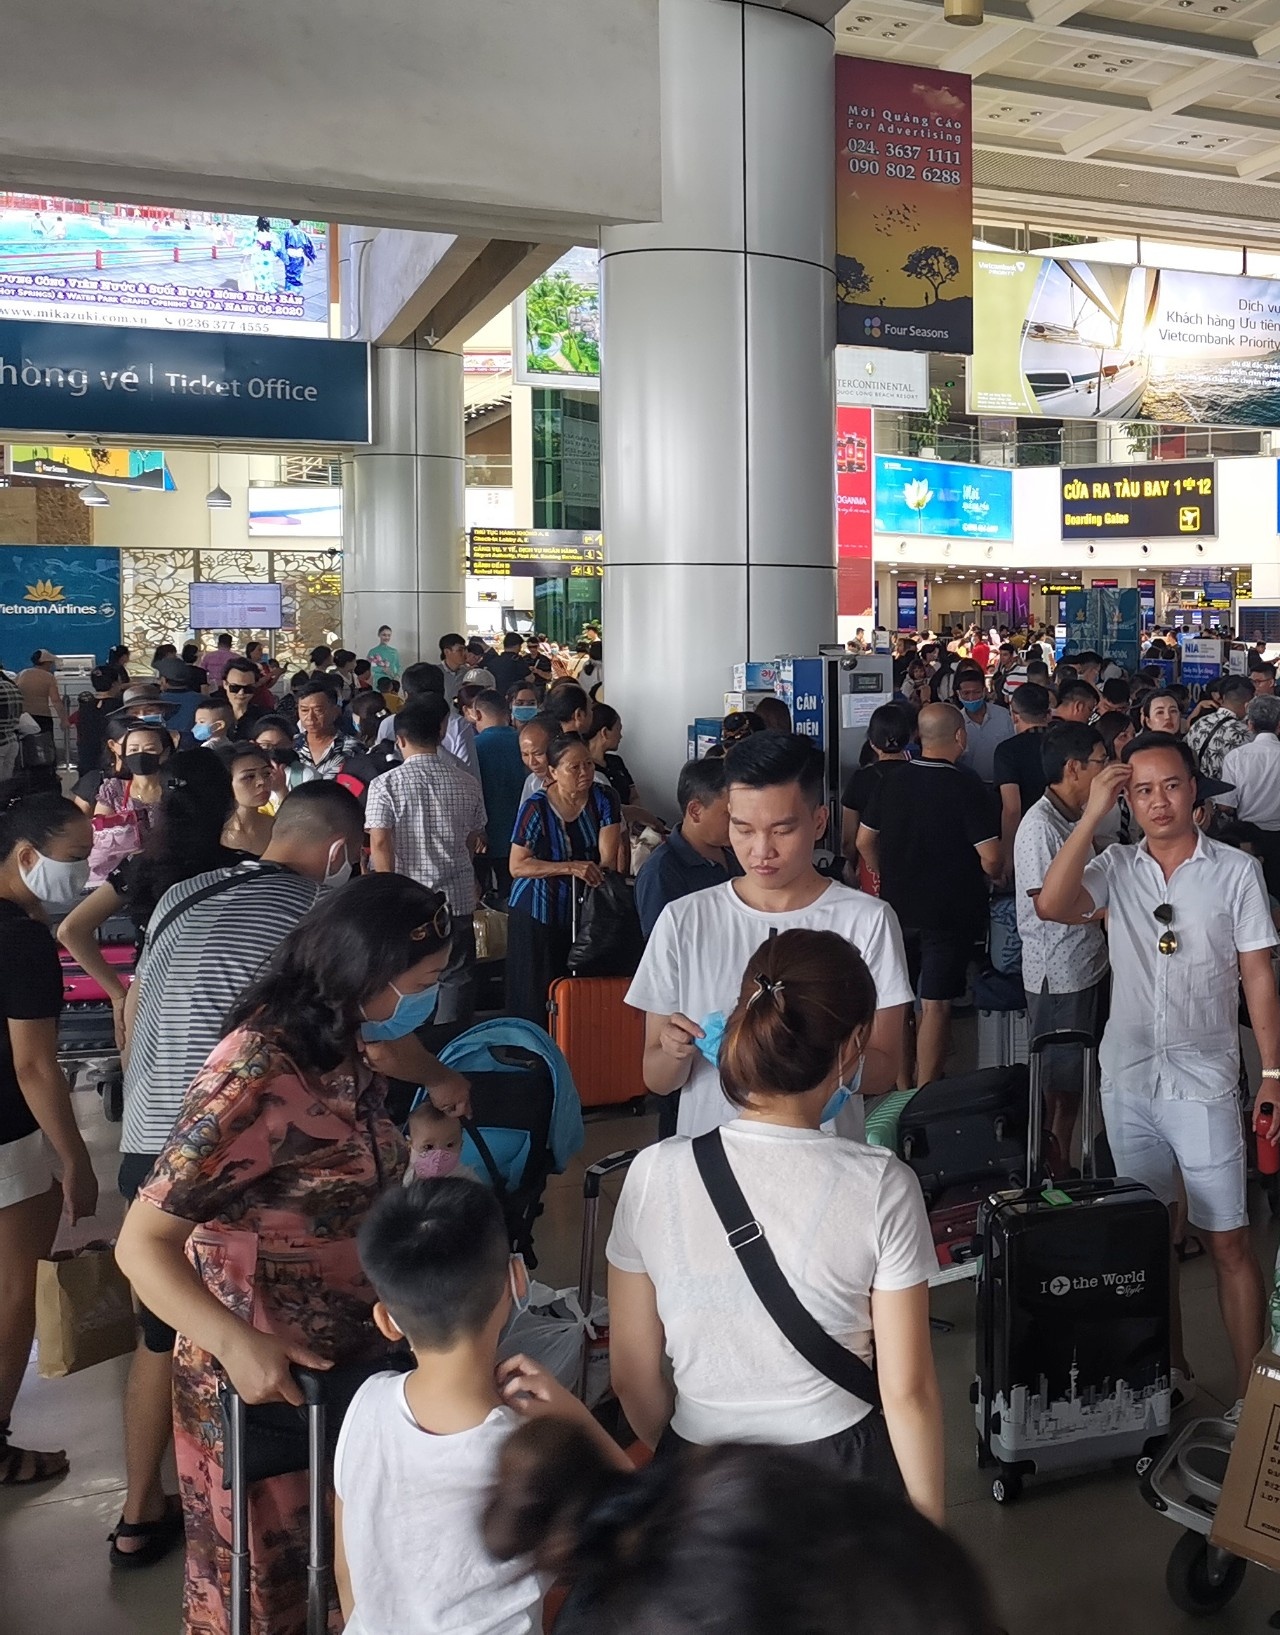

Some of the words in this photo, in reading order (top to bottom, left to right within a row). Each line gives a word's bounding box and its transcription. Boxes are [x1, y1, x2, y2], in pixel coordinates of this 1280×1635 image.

[848, 105, 875, 117] Mời
[882, 110, 928, 127] Quảng
[935, 117, 961, 130] Cáo
[848, 119, 871, 130] For
[878, 123, 961, 144] Advertising
[848, 138, 880, 155] 024.
[885, 143, 922, 160] 3637
[927, 148, 961, 165] 1111
[849, 158, 880, 175] 090
[886, 163, 916, 179] 802
[922, 167, 961, 185] 6288
[1238, 299, 1264, 313] Dịch
[1267, 304, 1280, 316] vụ
[178, 318, 209, 329] 0236
[213, 320, 235, 331] 377
[1166, 310, 1203, 325] Khách
[1207, 314, 1235, 330] hàng
[1260, 320, 1280, 331] tiên
[884, 324, 908, 336] Four
[909, 325, 949, 339] Seasons
[1158, 328, 1235, 346] Vietcombank
[1240, 335, 1280, 351] Priority
[100, 365, 139, 392] vé
[165, 373, 241, 398] Ticket
[248, 377, 318, 402] Office
[1063, 478, 1089, 500] CỬA
[1092, 482, 1111, 499] RA
[1114, 478, 1140, 498] TÀU
[1143, 480, 1170, 497] BAY
[1173, 479, 1181, 496] 1
[1196, 477, 1212, 495] 12
[1064, 513, 1103, 527] Boarding
[1104, 512, 1129, 525] Gates
[0, 603, 47, 615] ietnam
[48, 602, 97, 615] Airlines
[1184, 643, 1200, 654] NIA
[796, 693, 817, 710] CÂN
[1072, 1277, 1098, 1290] the
[1102, 1270, 1146, 1286] World
[1261, 1492, 1280, 1504] LOT
